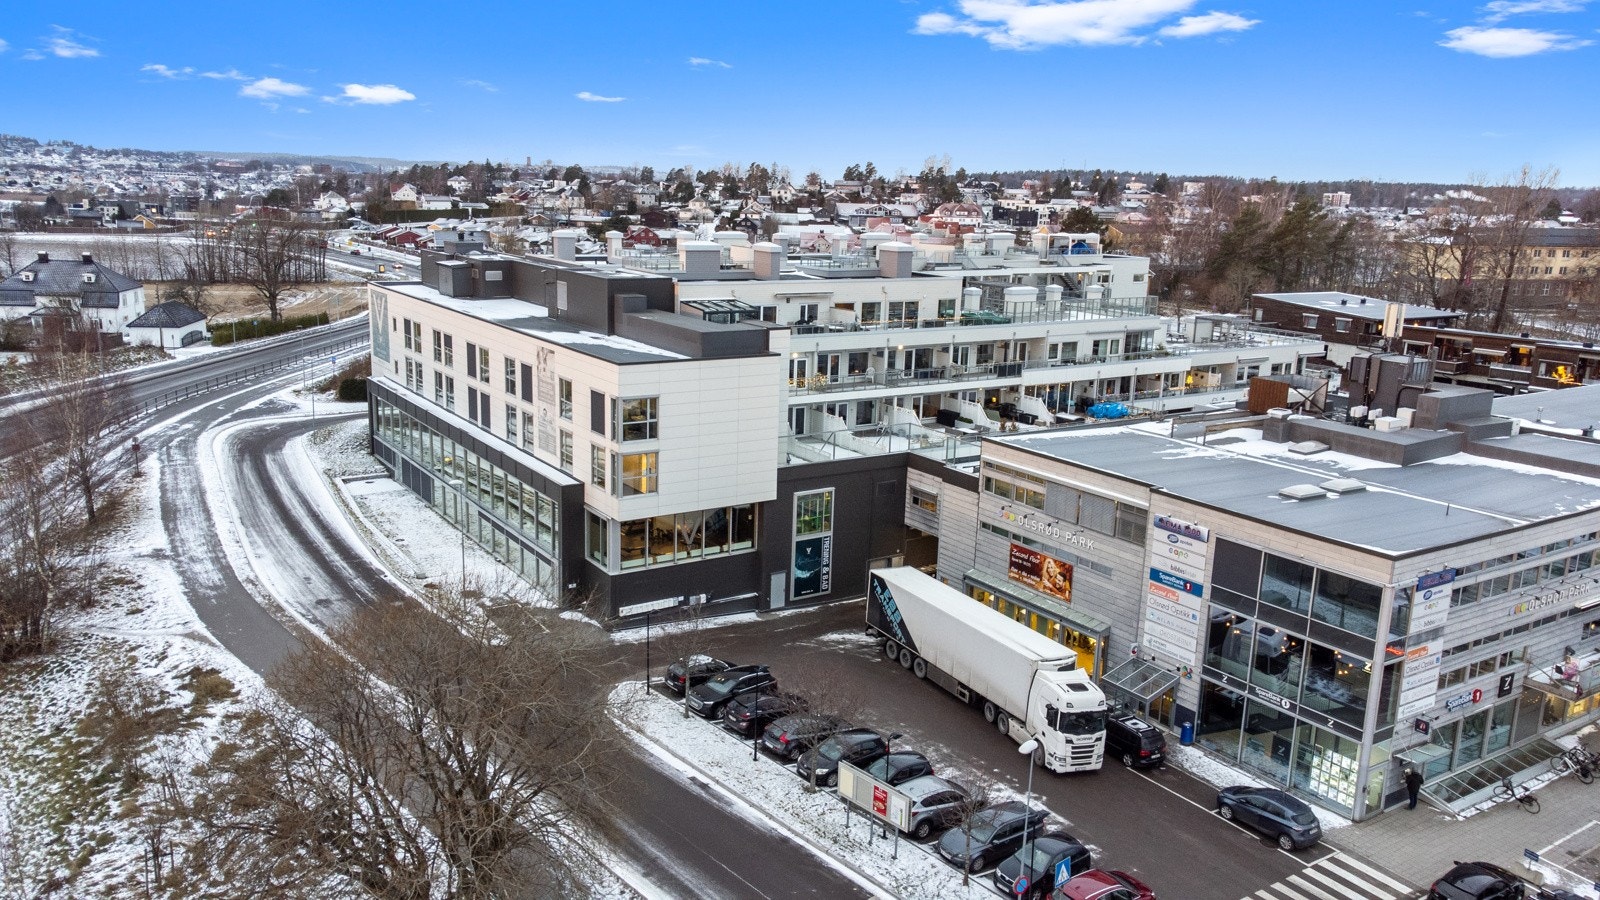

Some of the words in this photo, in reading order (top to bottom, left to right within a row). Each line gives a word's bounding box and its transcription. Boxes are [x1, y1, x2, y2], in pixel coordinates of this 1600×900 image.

[1018, 515, 1060, 538] OLSRØD
[1065, 531, 1095, 550] PARK
[823, 536, 831, 565] TRENING
[822, 566, 830, 574] &
[821, 574, 830, 590] BAD
[1158, 572, 1185, 586] SpareBank
[1568, 582, 1590, 598] PARK
[873, 578, 906, 644] TRANSPORT
[1503, 675, 1512, 691] Z
[1255, 686, 1281, 703] SpareBank
